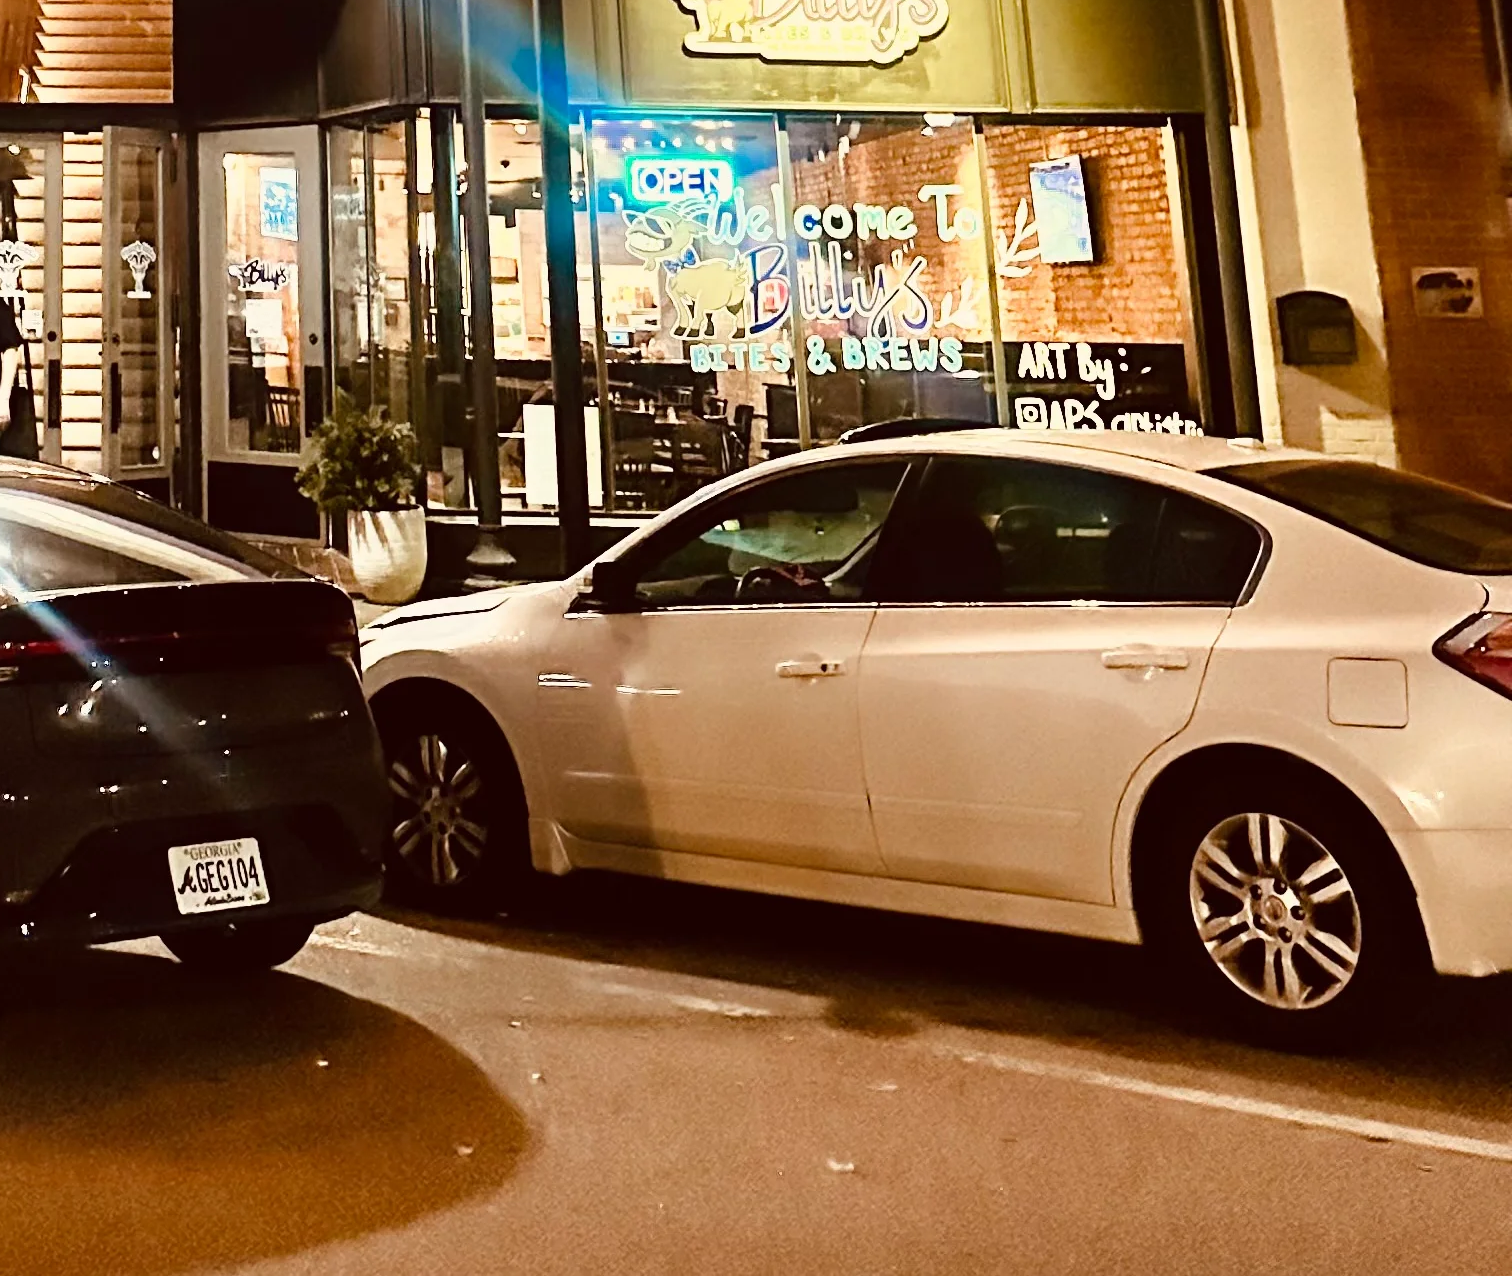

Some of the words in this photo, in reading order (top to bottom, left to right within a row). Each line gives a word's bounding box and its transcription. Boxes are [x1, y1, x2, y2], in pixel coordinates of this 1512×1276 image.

[640, 167, 721, 195] OPEN
[918, 184, 979, 242] To
[690, 343, 792, 373] BITES
[806, 334, 837, 376] &
[841, 336, 963, 373] BREWS
[1017, 342, 1071, 380] ART
[189, 842, 241, 861] GEORGIA
